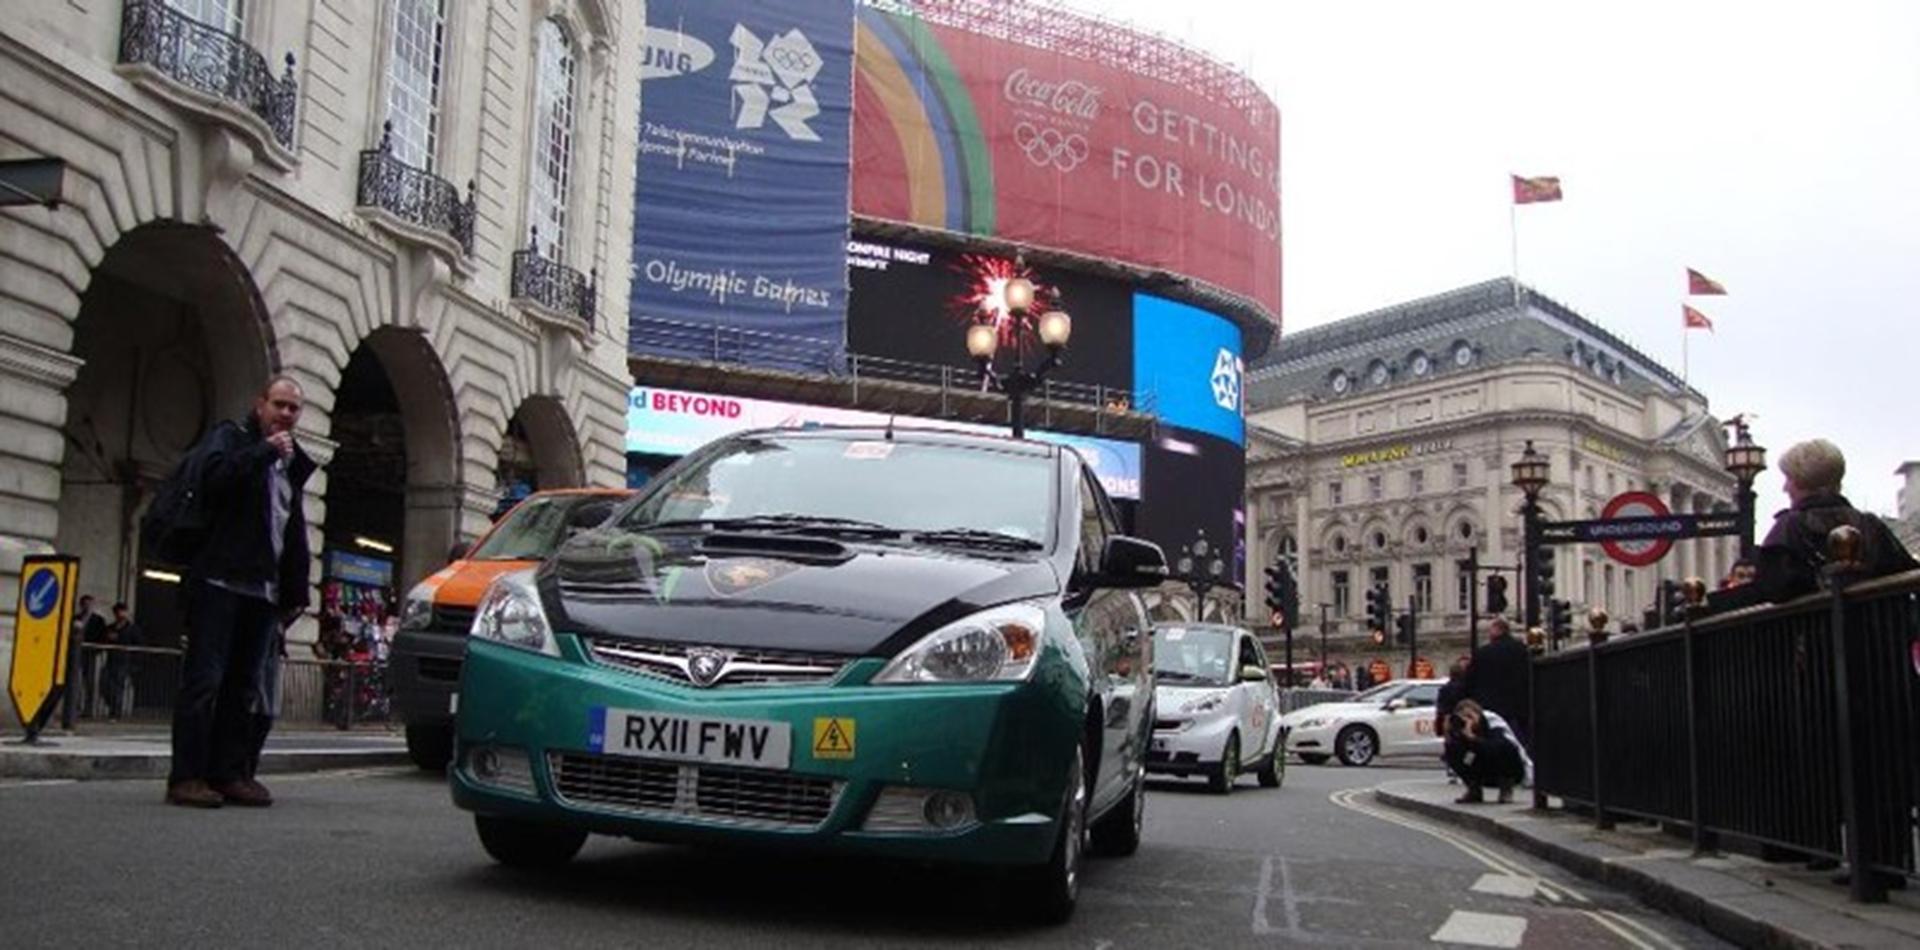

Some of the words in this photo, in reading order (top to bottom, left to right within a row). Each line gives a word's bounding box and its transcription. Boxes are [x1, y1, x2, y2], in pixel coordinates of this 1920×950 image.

[1132, 101, 1262, 178] GETTING
[1112, 148, 1184, 196] FOR
[646, 260, 748, 299] Olympic
[753, 275, 831, 308] Games
[652, 392, 741, 419] BEYOND
[1589, 521, 1682, 537] UNDERGROUND
[698, 721, 770, 761] FWV
